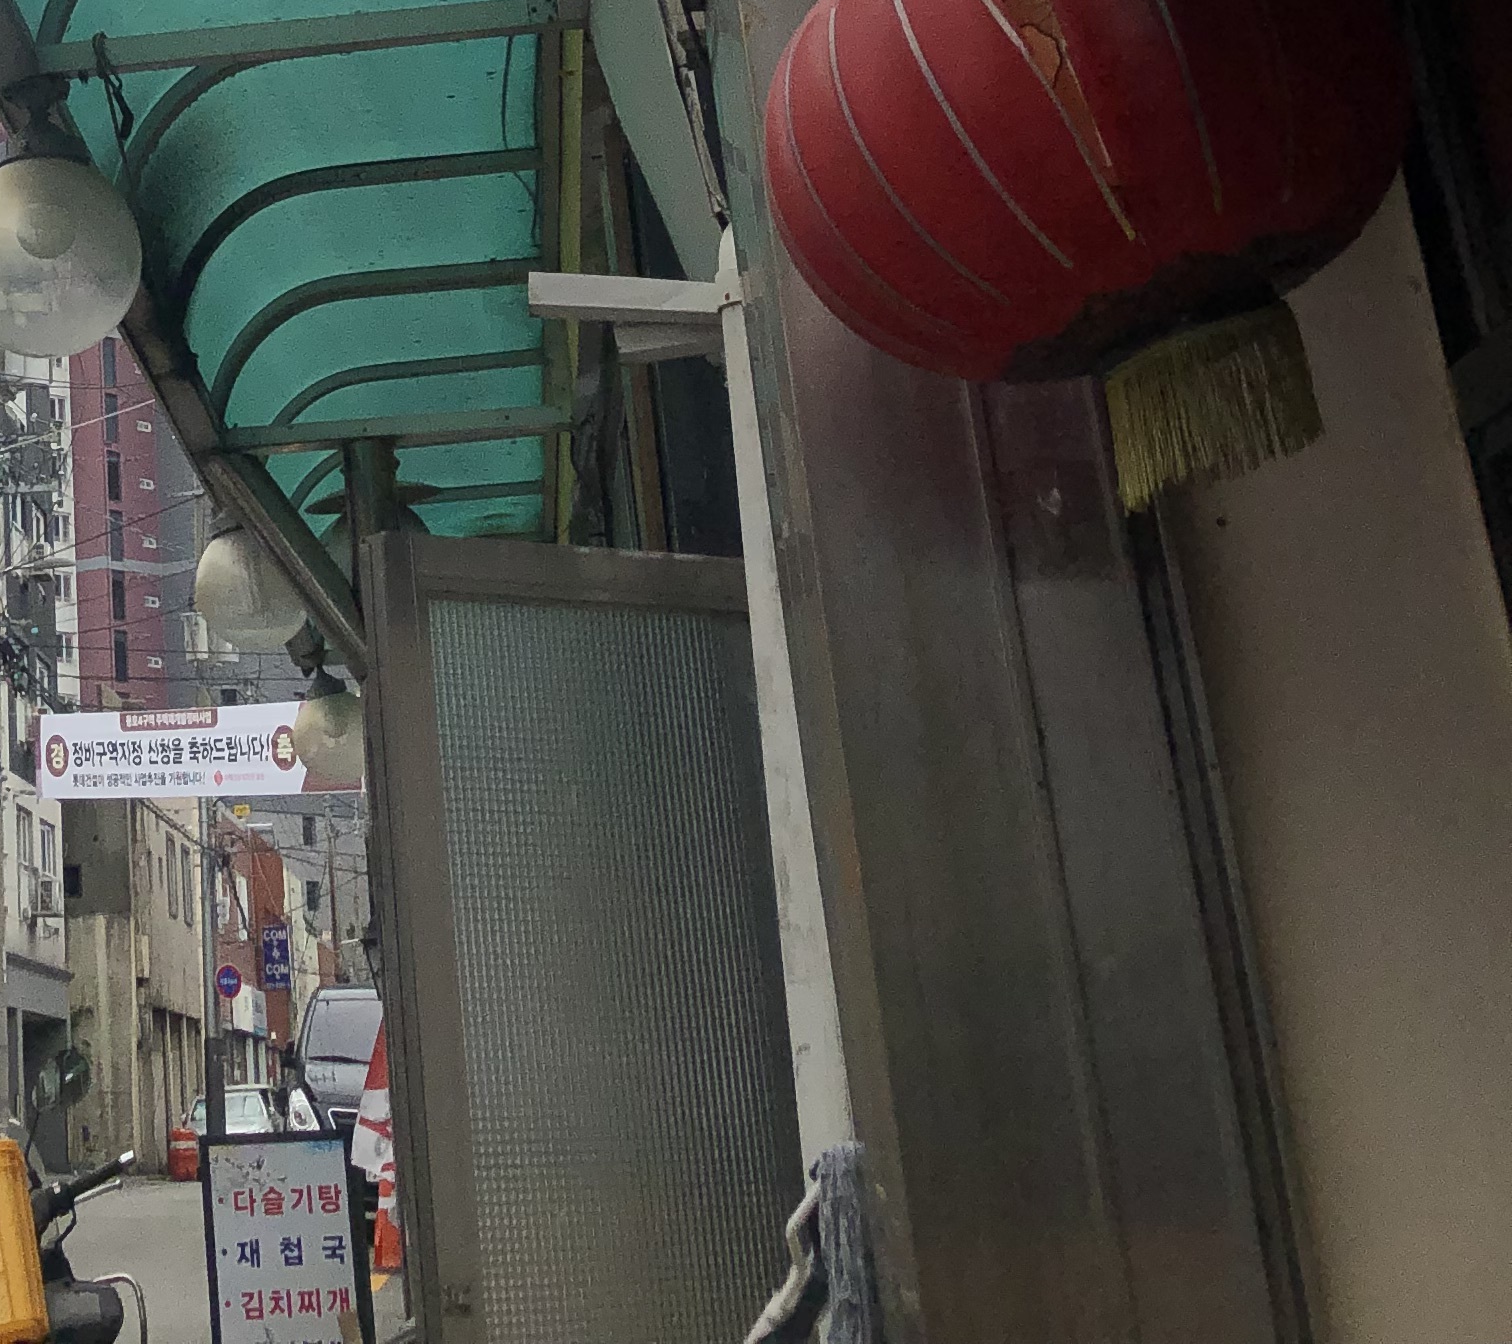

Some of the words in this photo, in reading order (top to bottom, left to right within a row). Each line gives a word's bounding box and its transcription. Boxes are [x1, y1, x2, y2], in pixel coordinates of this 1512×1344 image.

[50, 742, 65, 769] 경
[72, 739, 143, 768] 정비구역지정
[148, 737, 184, 765] 신청을
[188, 733, 270, 764] 축하드립니다!
[232, 1183, 342, 1217] 다슬기탕
[236, 1235, 346, 1269] 재첩국
[240, 1287, 351, 1321] 김치찌개
